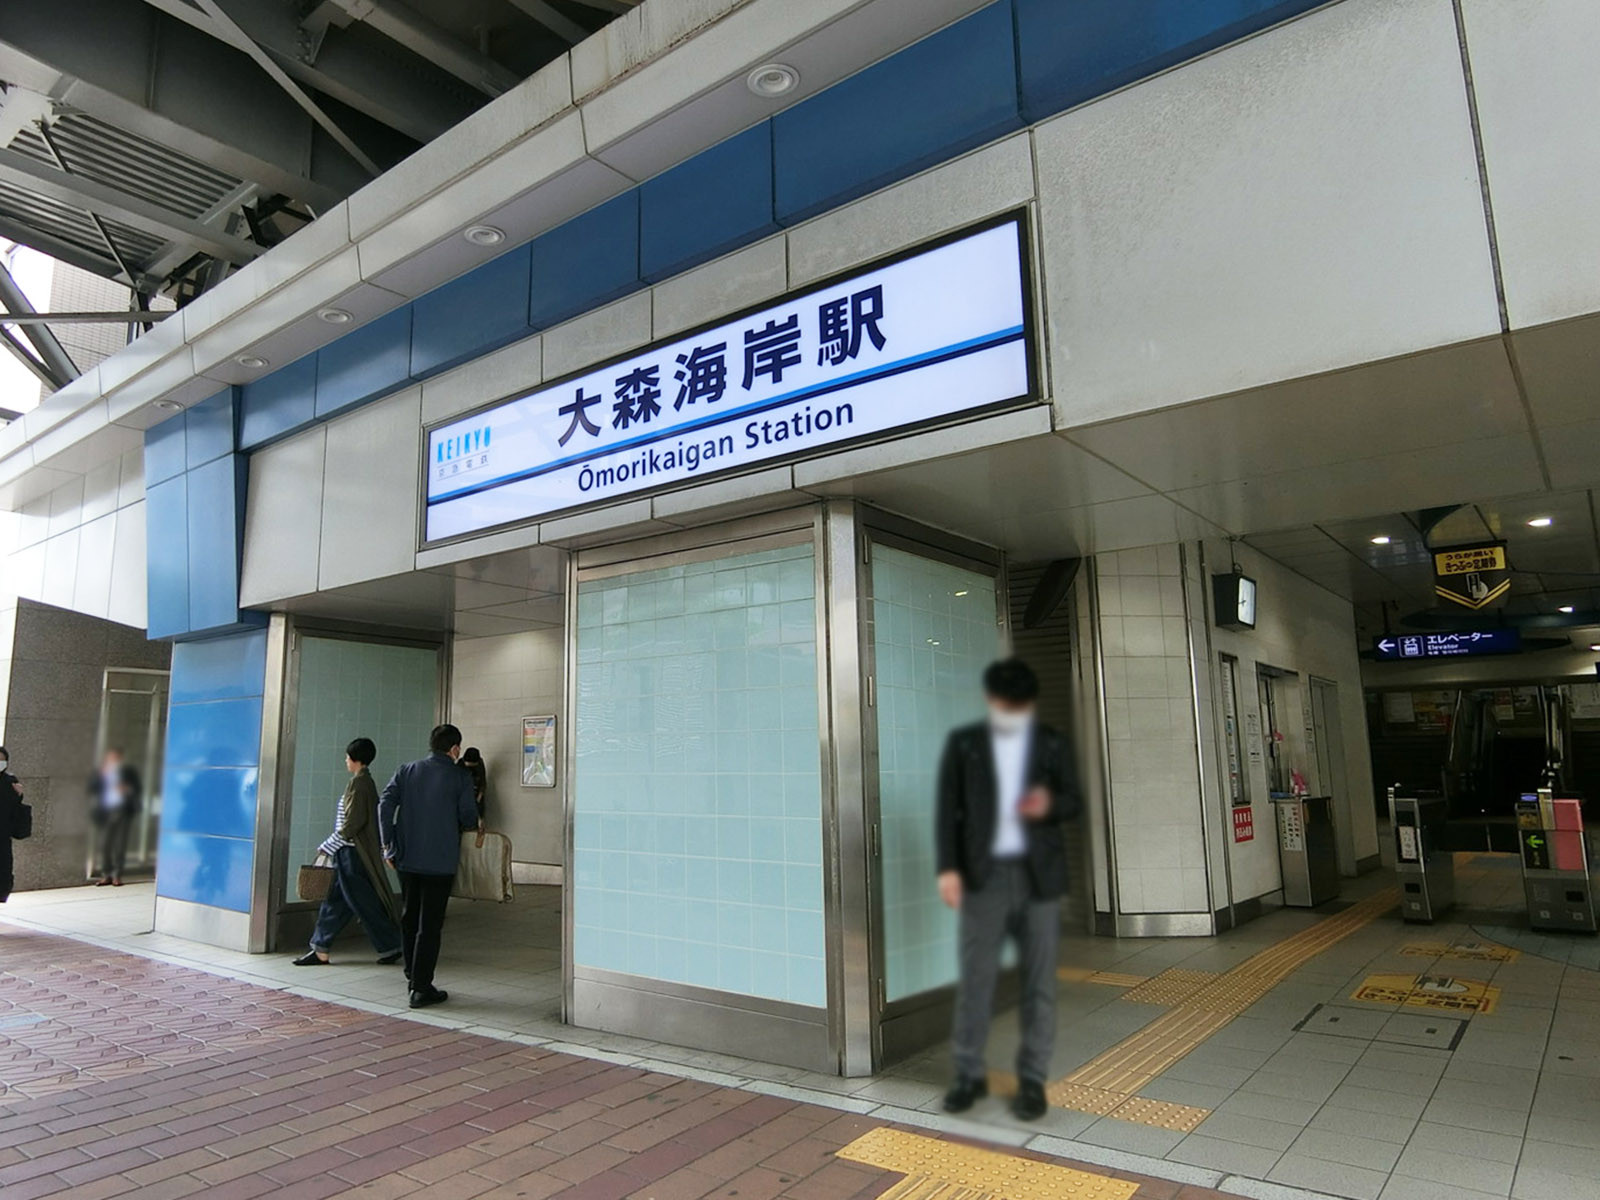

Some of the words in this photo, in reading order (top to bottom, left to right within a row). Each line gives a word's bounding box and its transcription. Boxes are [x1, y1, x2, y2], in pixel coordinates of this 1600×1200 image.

[557, 284, 887, 448] 大森海岸駅
[437, 426, 491, 463] KEIKYU
[578, 436, 734, 492] Ōmorikaigan
[745, 403, 854, 450] Station
[1426, 632, 1494, 644] エレベーター
[1427, 643, 1459, 651] Elevator
